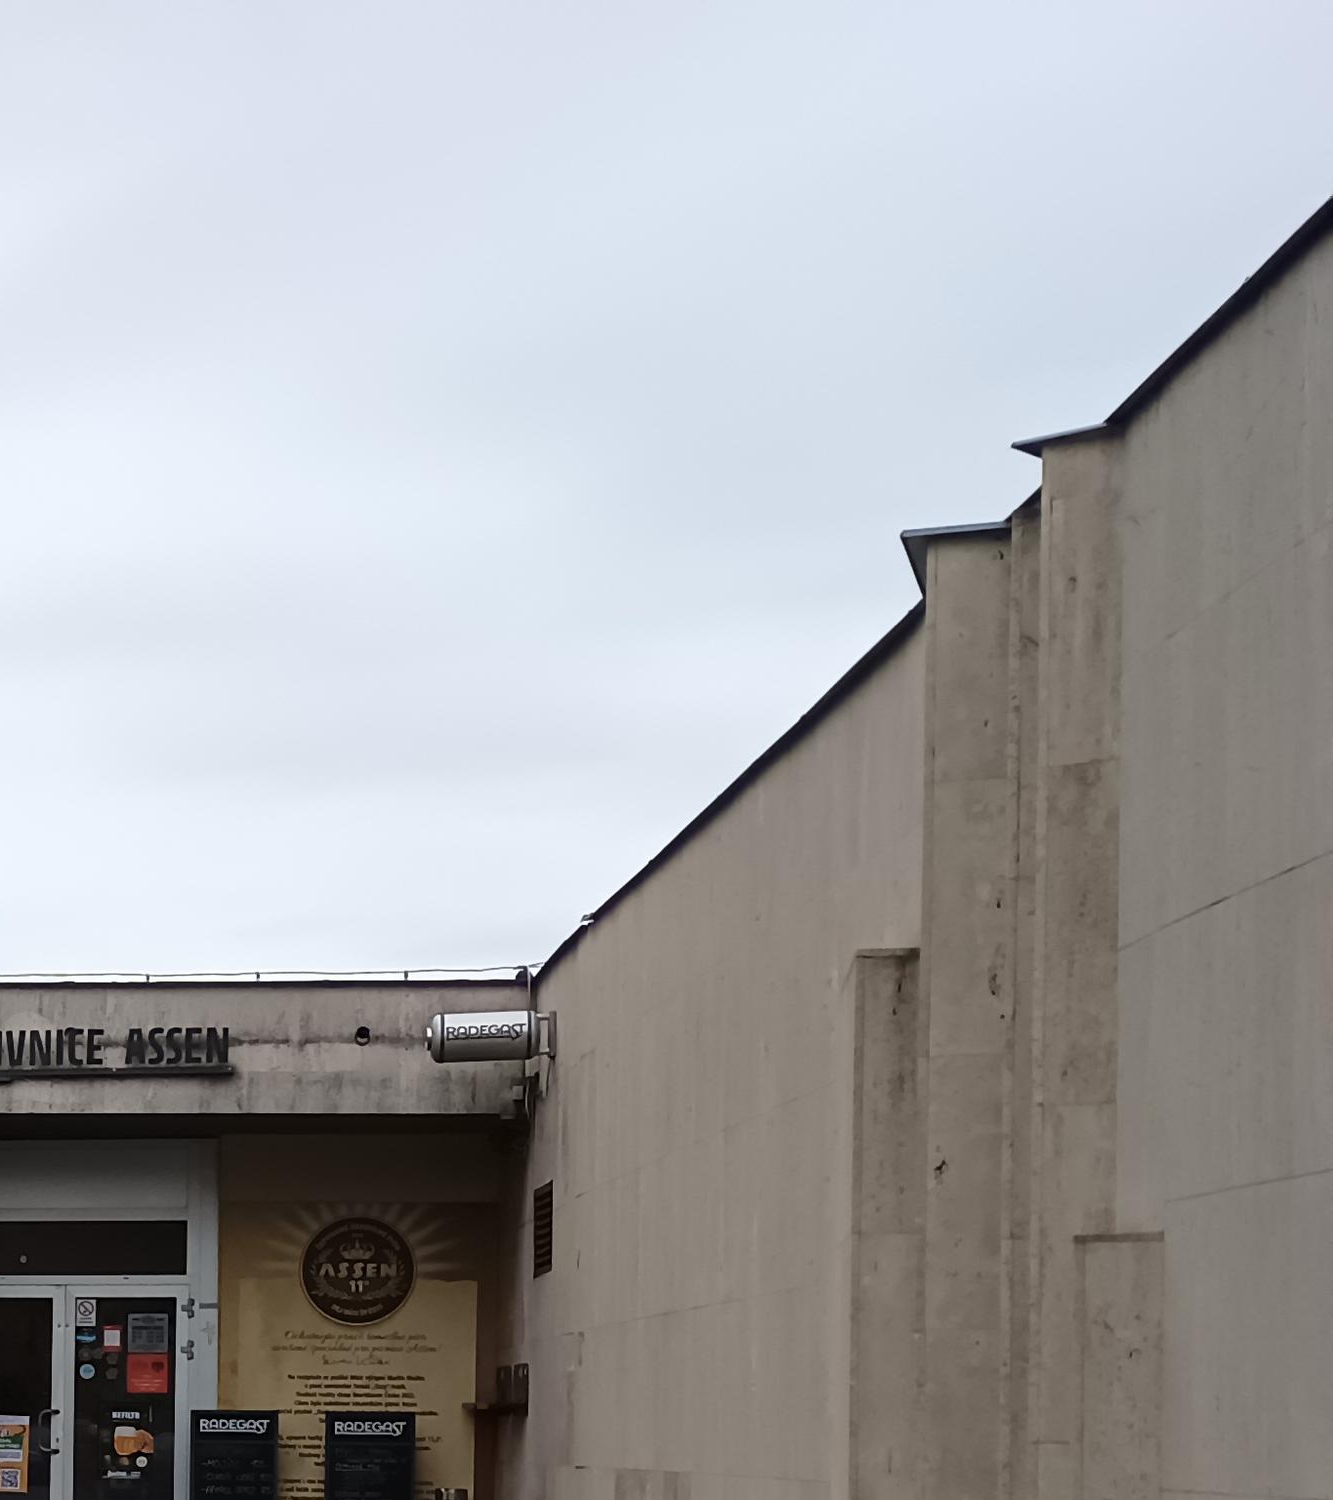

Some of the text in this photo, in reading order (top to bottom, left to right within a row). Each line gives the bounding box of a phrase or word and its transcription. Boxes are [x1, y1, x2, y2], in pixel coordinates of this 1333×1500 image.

[446, 1023, 526, 1041] RADEGAST
[125, 1027, 229, 1065] ASSEN
[319, 1262, 397, 1278] ASSEN
[200, 1419, 270, 1434] RADEGAST
[335, 1421, 407, 1436] RADEGAST
